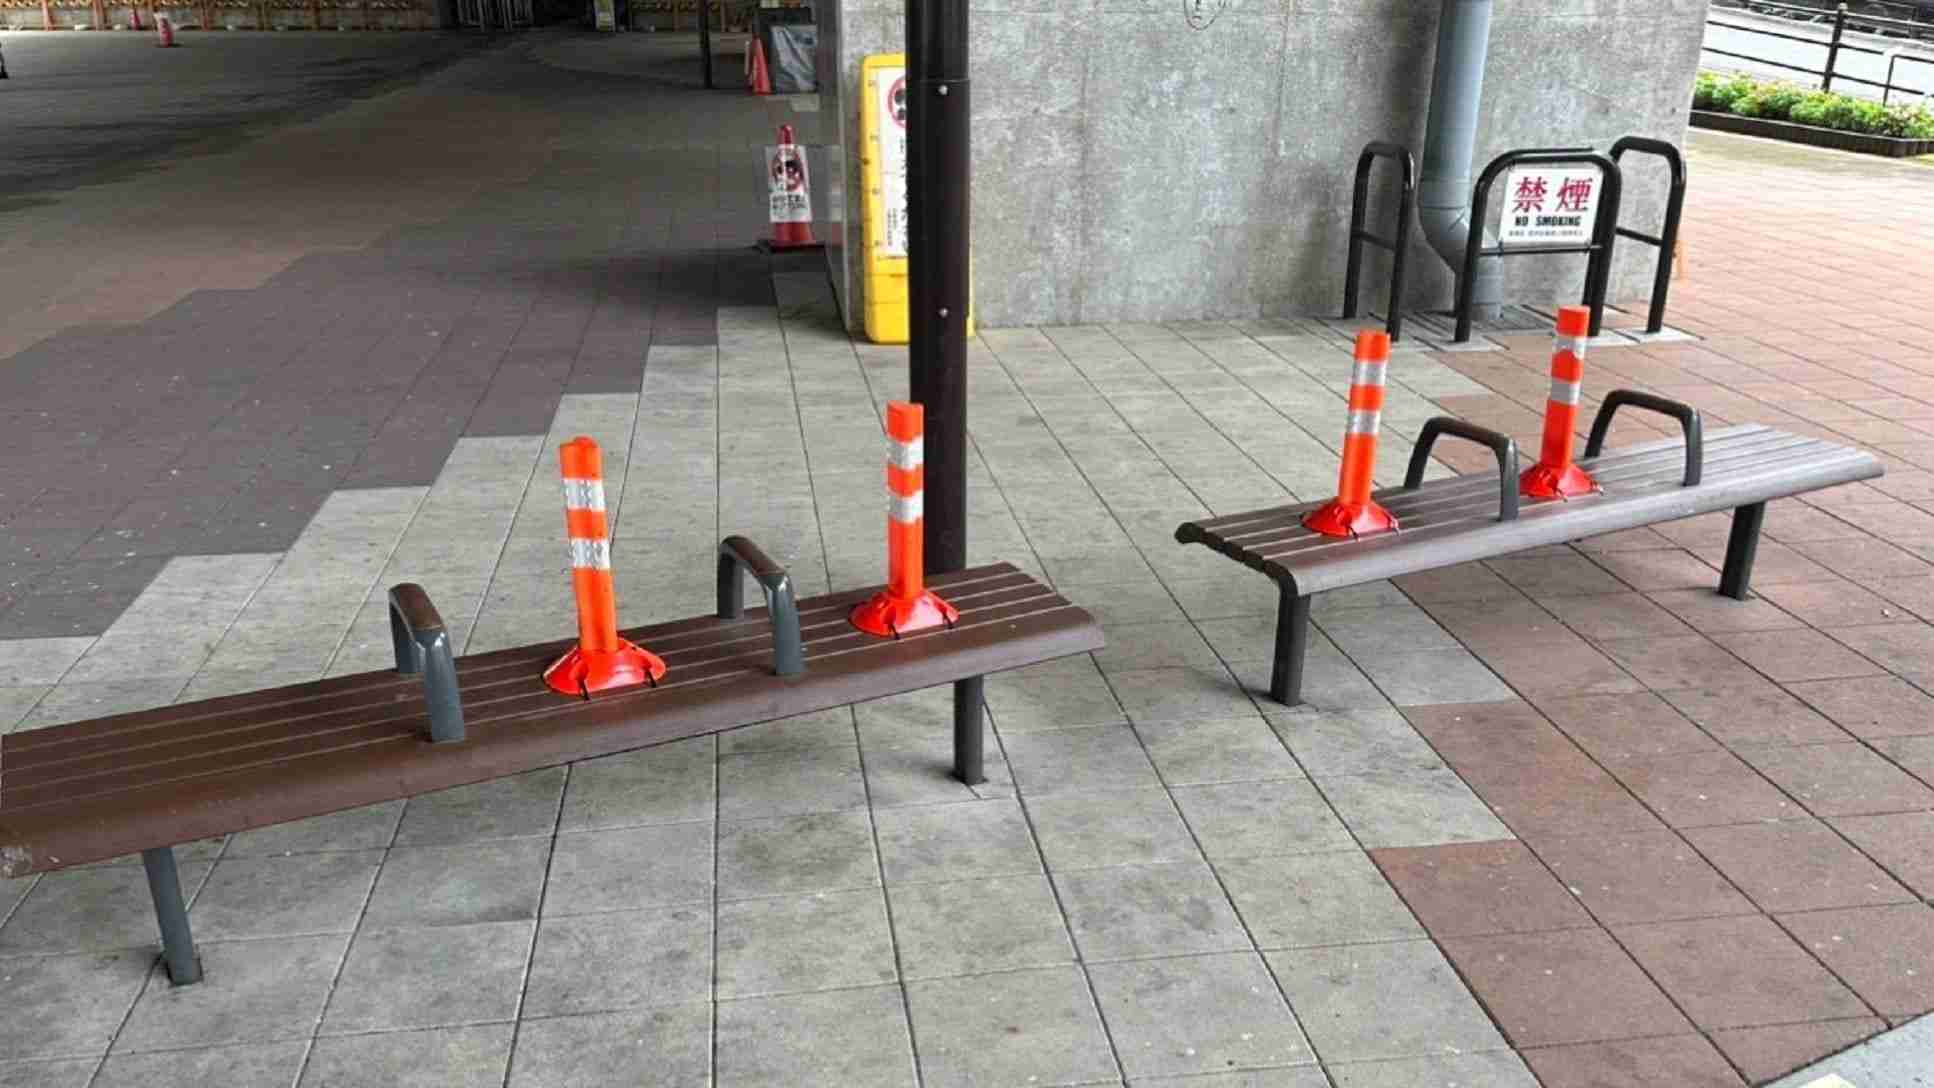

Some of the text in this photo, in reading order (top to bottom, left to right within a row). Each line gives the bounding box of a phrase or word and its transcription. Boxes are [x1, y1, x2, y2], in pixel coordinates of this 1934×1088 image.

[1512, 176, 1593, 213] 禁煙
[1515, 215, 1581, 226] NO SMOKING
